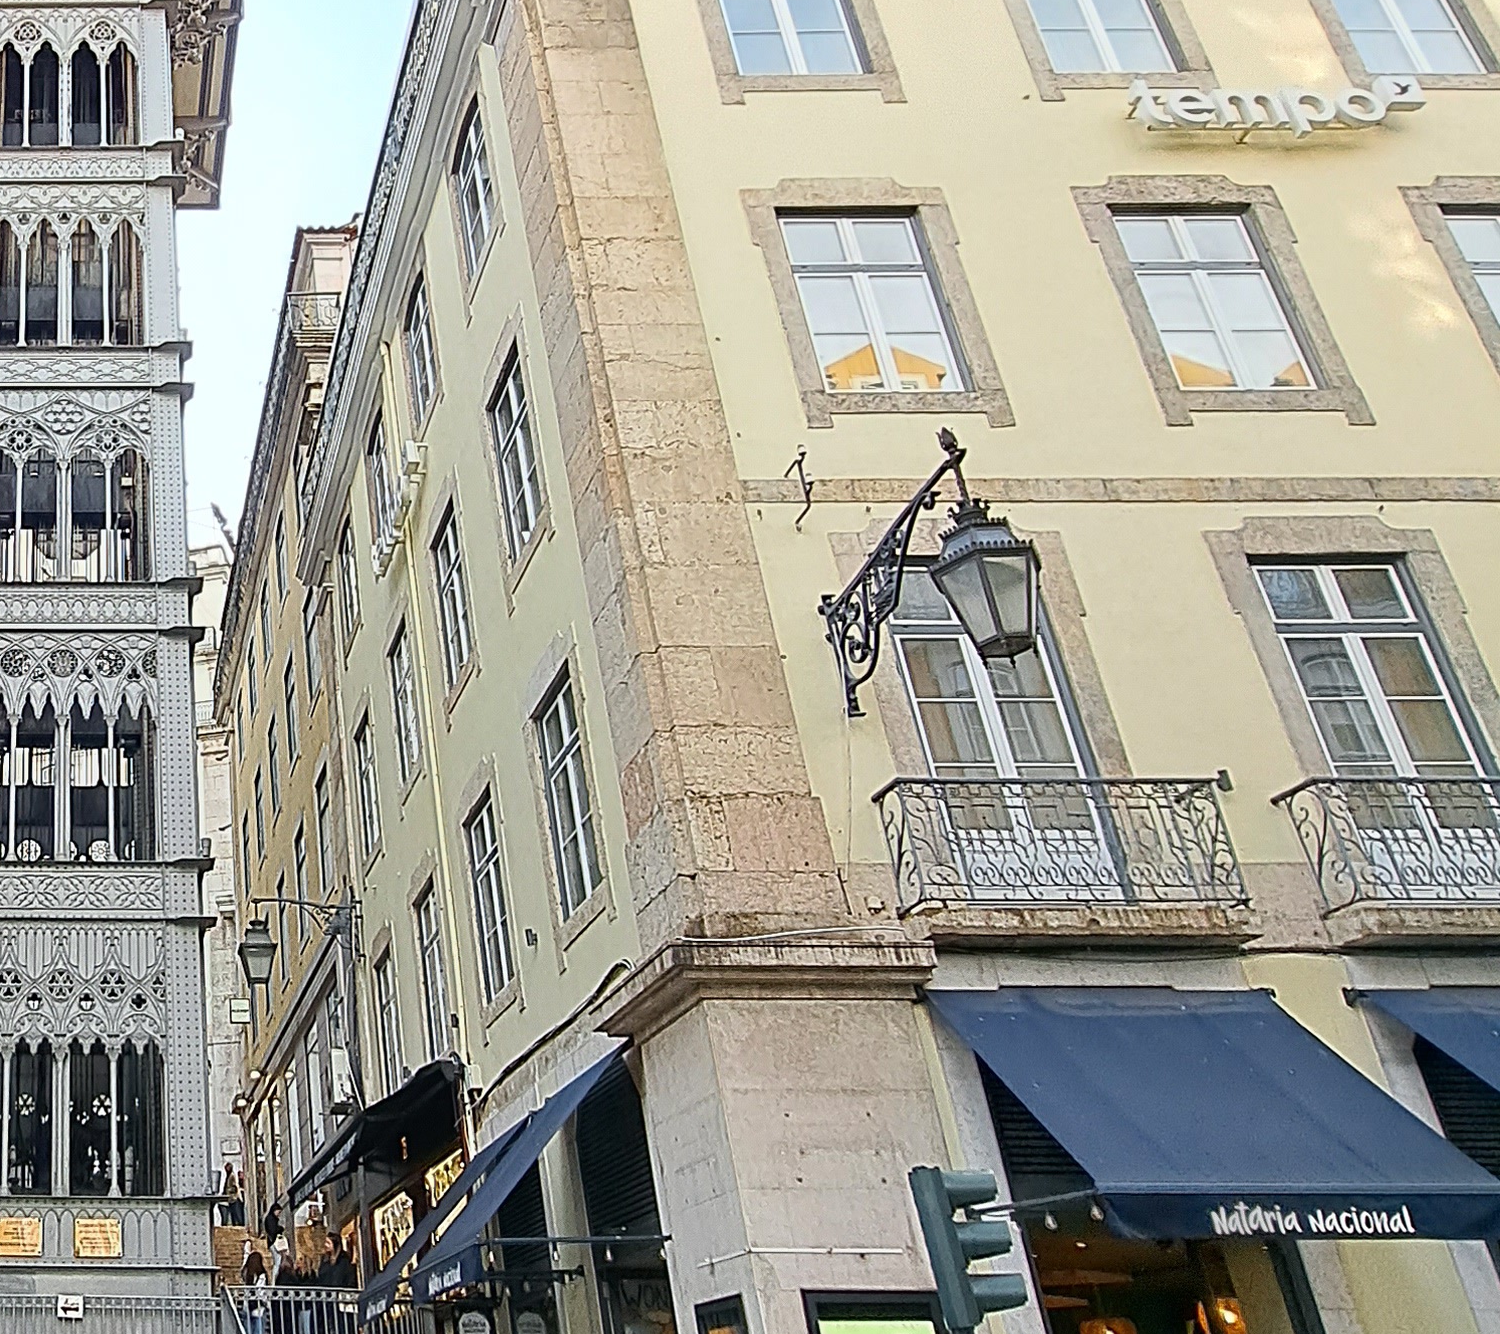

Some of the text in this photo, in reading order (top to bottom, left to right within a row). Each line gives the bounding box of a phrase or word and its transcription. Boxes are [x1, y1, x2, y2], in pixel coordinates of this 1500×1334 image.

[1127, 78, 1387, 139] tempo
[1210, 1201, 1416, 1235] Nataria Nacional
